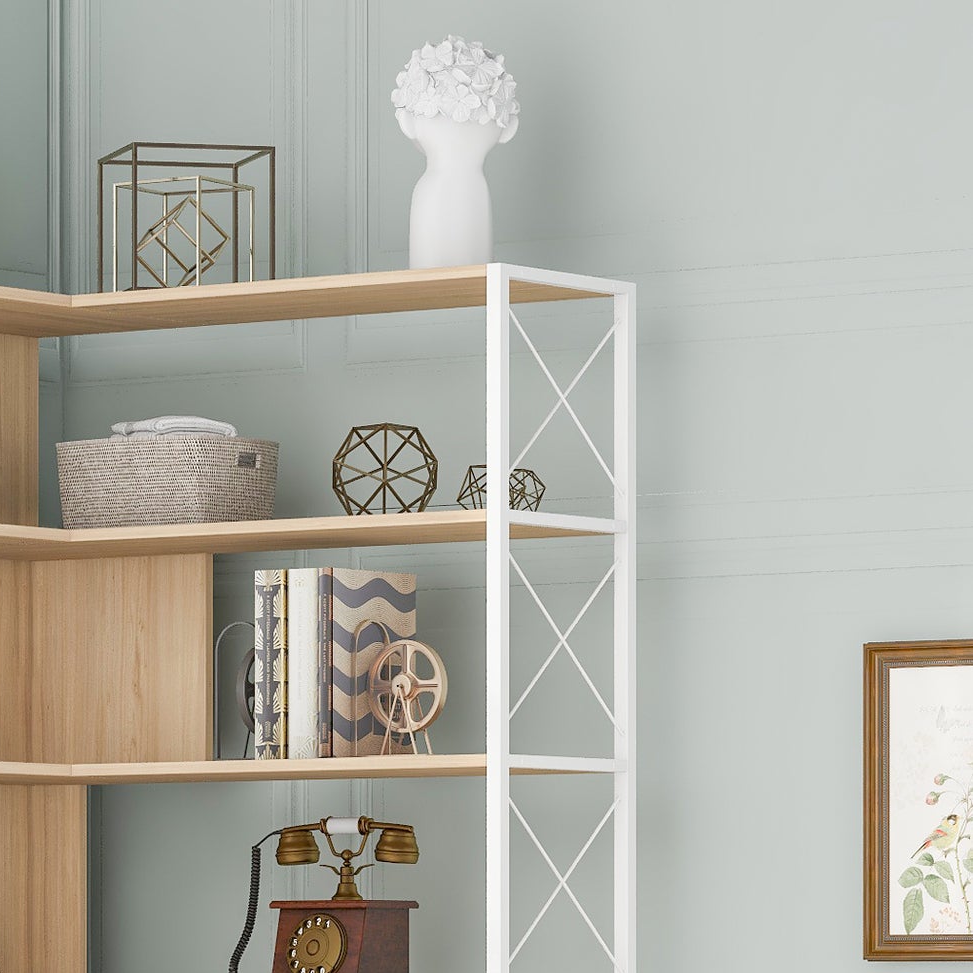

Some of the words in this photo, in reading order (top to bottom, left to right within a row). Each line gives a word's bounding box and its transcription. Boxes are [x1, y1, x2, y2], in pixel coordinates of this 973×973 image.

[307, 920, 312, 929] 3
[317, 917, 322, 926] 2
[326, 920, 330, 928] 1
[298, 927, 303, 935] 4
[292, 938, 297, 946] 5
[291, 949, 296, 958] 6
[294, 960, 299, 969] 7
